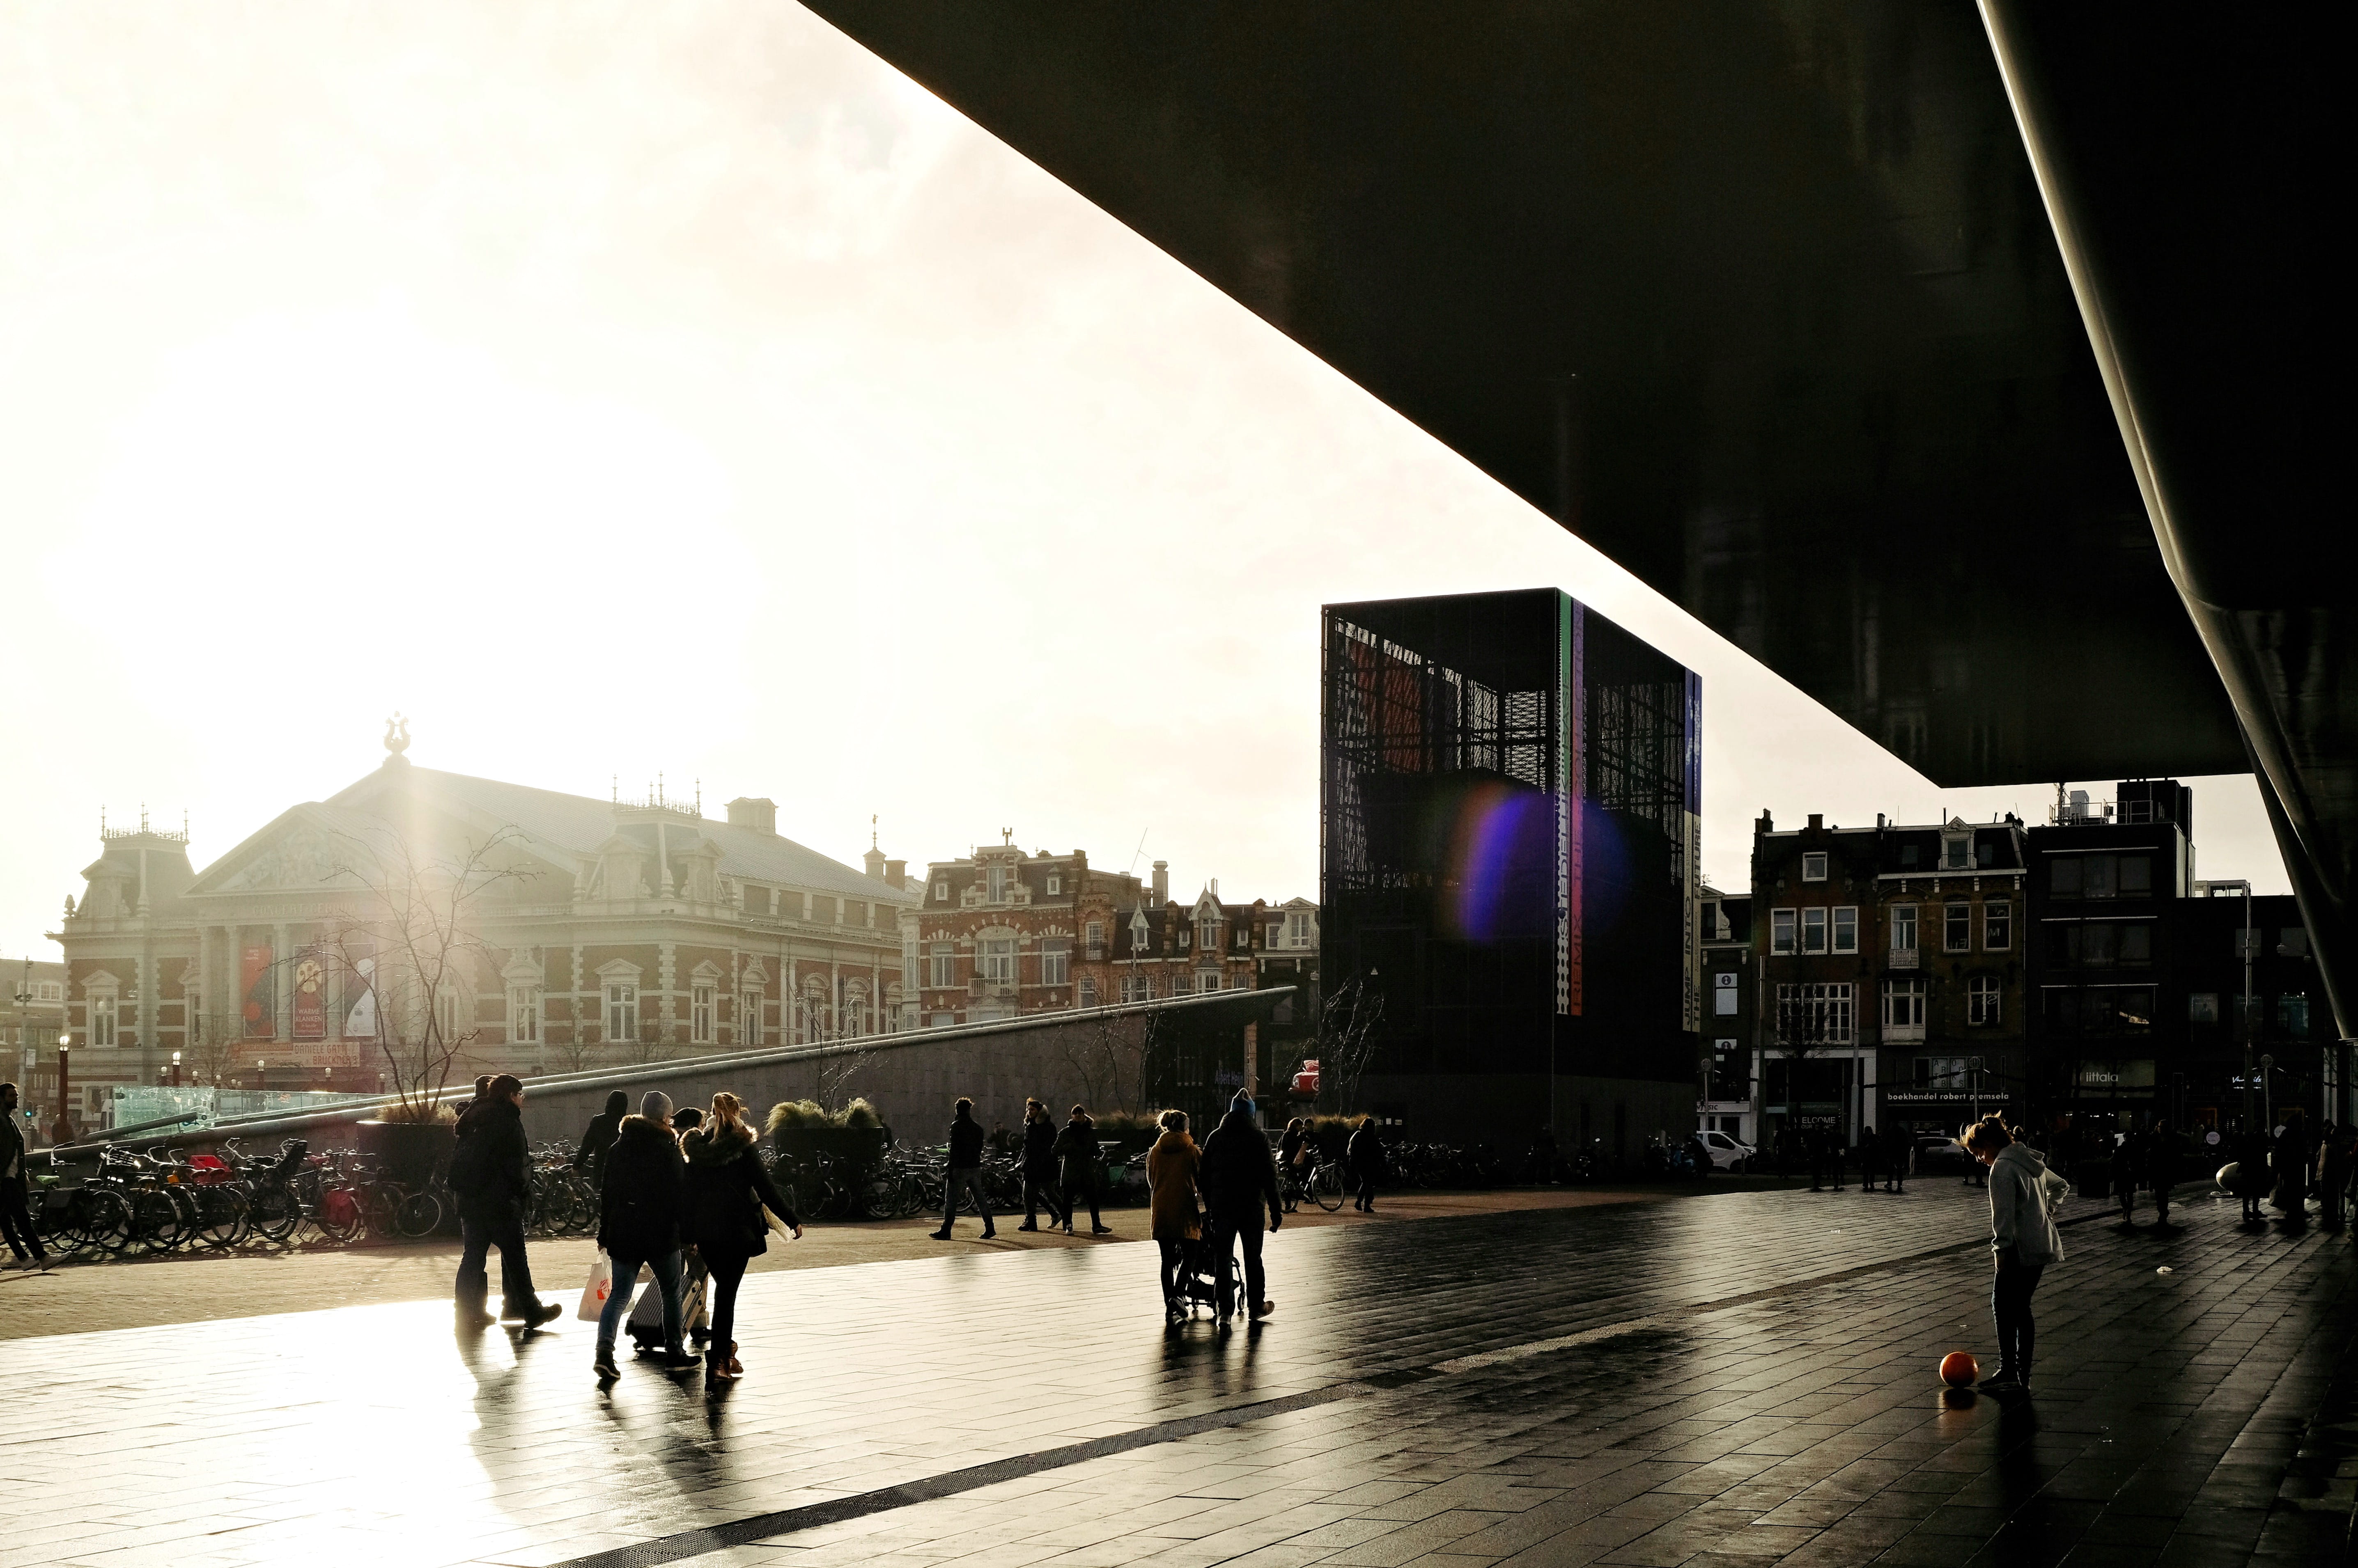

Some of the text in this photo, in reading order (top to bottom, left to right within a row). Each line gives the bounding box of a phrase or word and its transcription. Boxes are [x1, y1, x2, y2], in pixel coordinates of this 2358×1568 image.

[1562, 672, 1570, 750] BASE
[1573, 828, 1582, 886] THE
[1573, 914, 1582, 1007] REMIX
[294, 1045, 324, 1054] DANIELE
[1215, 1070, 1230, 1085] Albert
[2086, 1072, 2119, 1082] iittala
[1970, 1093, 2009, 1101] pemsela
